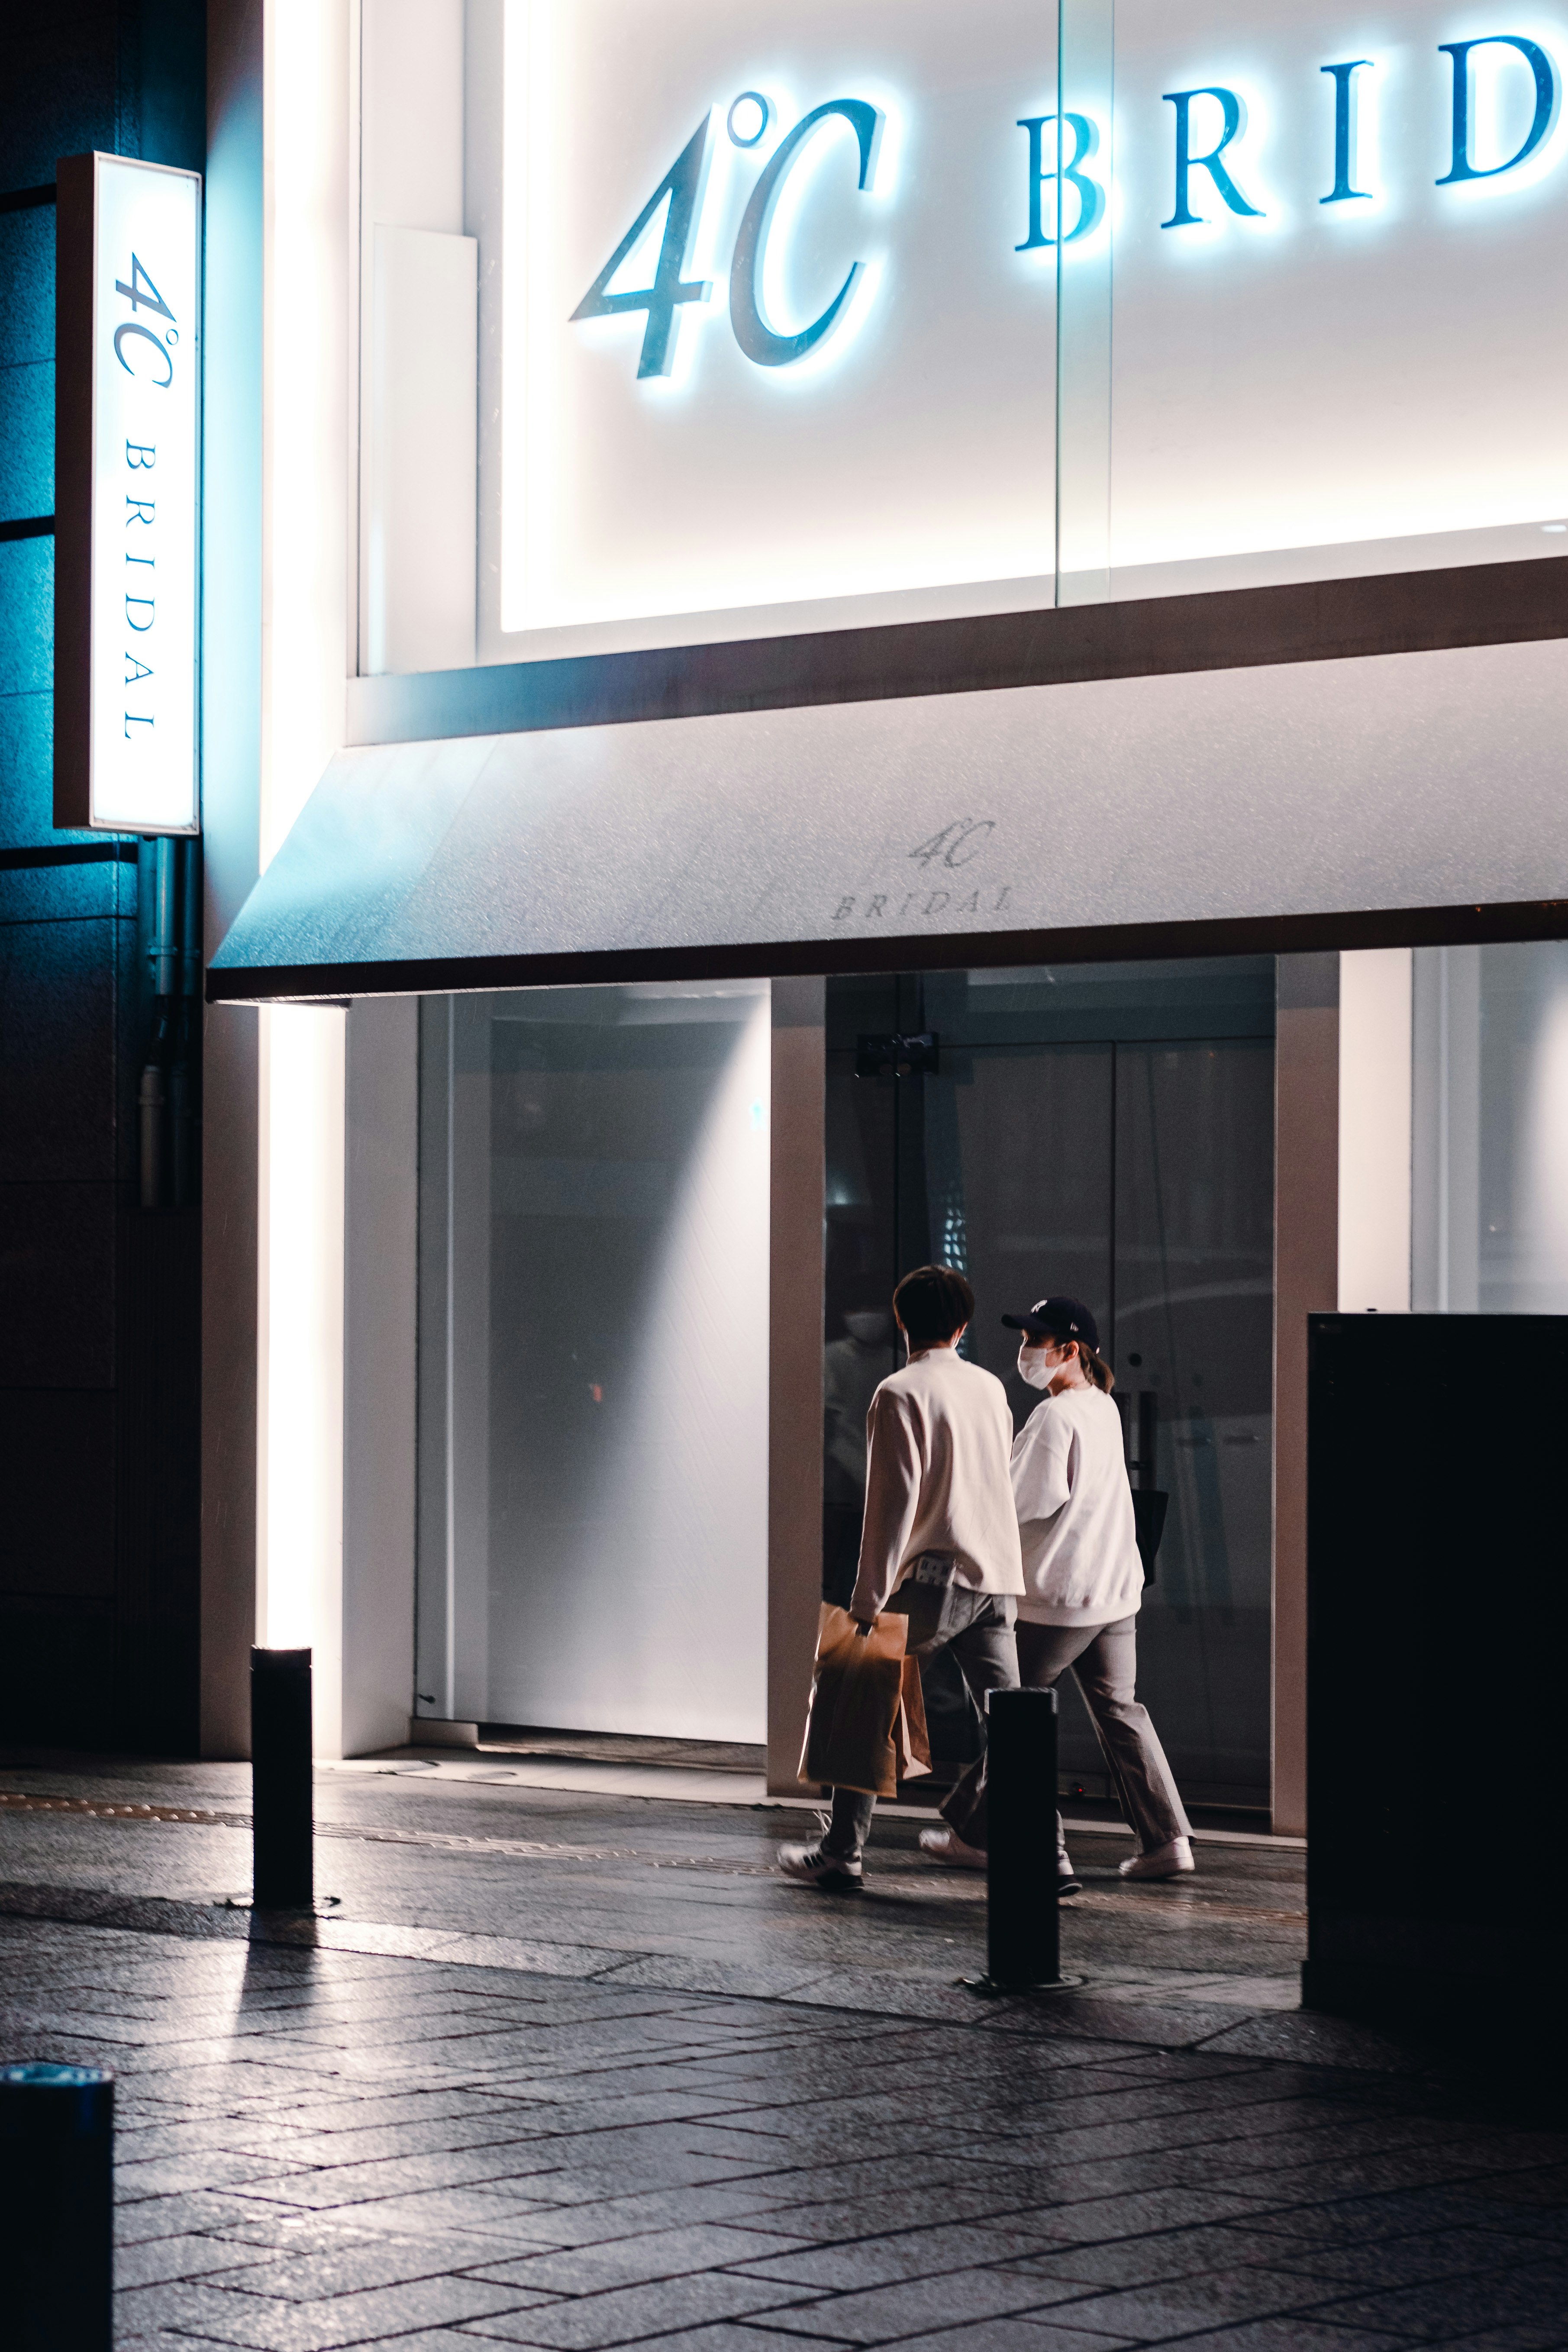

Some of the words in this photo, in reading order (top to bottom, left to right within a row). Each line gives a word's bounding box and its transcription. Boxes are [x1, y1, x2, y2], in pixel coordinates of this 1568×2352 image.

[1015, 35, 1562, 252] BRID
[125, 439, 155, 739] BRIDAL
[830, 887, 1011, 920] BRIDAL
